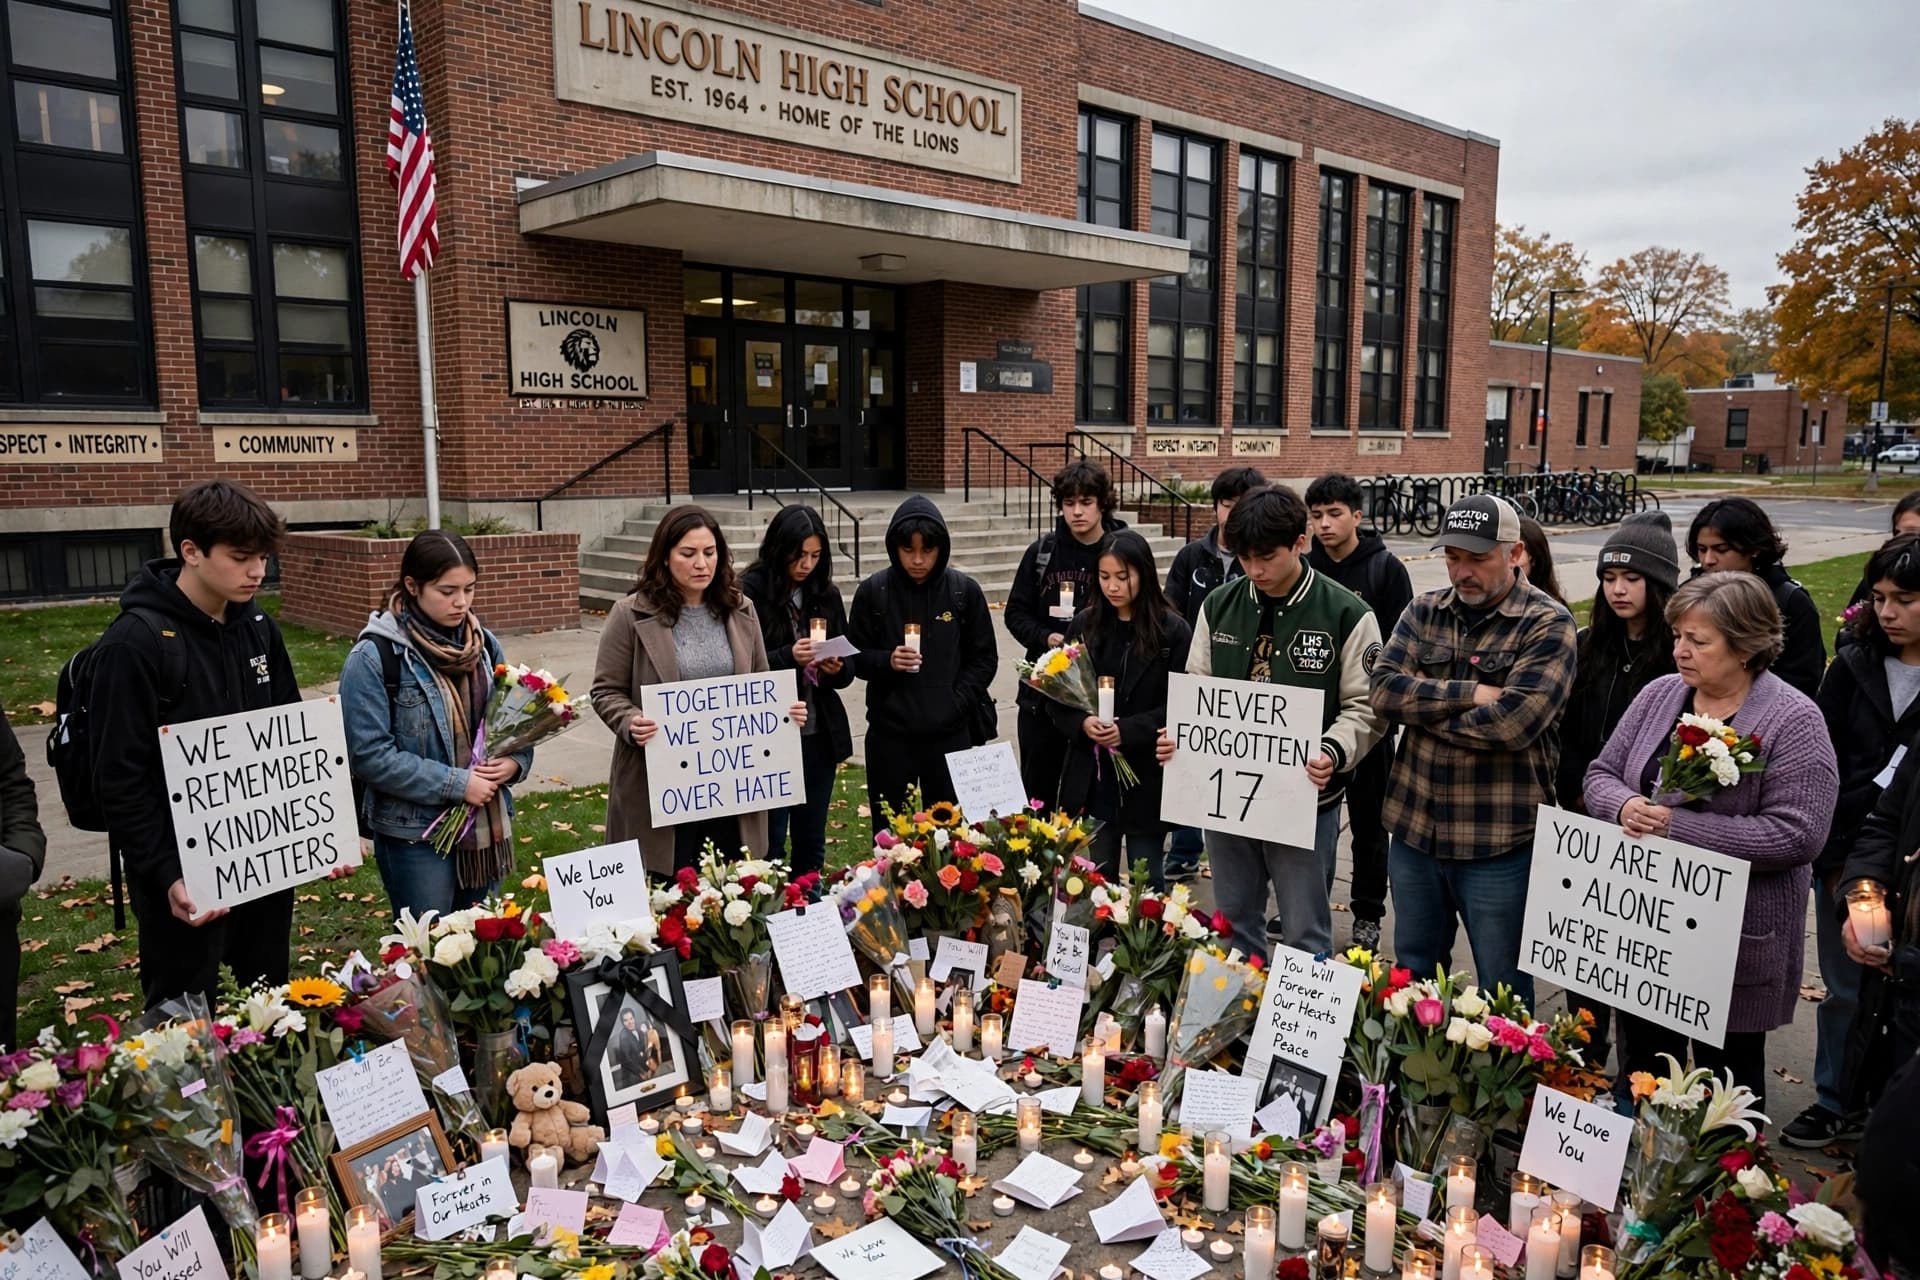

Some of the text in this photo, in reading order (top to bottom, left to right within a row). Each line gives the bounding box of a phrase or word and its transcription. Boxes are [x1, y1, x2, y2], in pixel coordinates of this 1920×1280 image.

[579, 1, 1008, 136] LINCOLN HIGH SCHOOL
[651, 75, 960, 154] EST. 1964 HOME OF THE LIONS
[539, 310, 618, 333] LINCOLN
[520, 372, 639, 392] HIGH SCHOOL
[69, 434, 148, 454] INTEGRITY
[239, 436, 335, 454] COMMUNITY
[1448, 519, 1481, 531] PARENT
[1303, 634, 1323, 647] LHS
[1298, 657, 1324, 669] 2026
[658, 679, 777, 716] TOGETHER
[1197, 686, 1288, 727] NEVER
[176, 711, 318, 766] WE WILL
[664, 711, 778, 746] WE STAND
[1176, 722, 1309, 767] FORGOTTEN
[697, 744, 755, 775] LOVE
[185, 749, 333, 814] REMEMBER
[662, 771, 792, 815] OVER HATE
[1207, 767, 1264, 822] 17
[204, 791, 335, 857] KINDNESS
[216, 832, 338, 900] MATTERS
[555, 859, 625, 887] We Love
[1553, 821, 1732, 902] YOU ARE NOT
[583, 887, 614, 909] You
[1582, 877, 1675, 934] ALONE
[1549, 911, 1673, 977] WE'RE HERE
[1284, 955, 1334, 984] You Will
[1531, 940, 1711, 1031] FOR EACH OTHER
[1279, 975, 1342, 1005] Forever in
[1273, 993, 1337, 1025] Our Hearts
[1272, 1012, 1318, 1041] Rest in
[1273, 1032, 1310, 1058] Peace
[1545, 1096, 1610, 1142] We Love
[1558, 1131, 1585, 1163] You
[480, 1176, 492, 1187] in
[455, 1193, 491, 1215] Hearts
[133, 1229, 191, 1280] You Will
